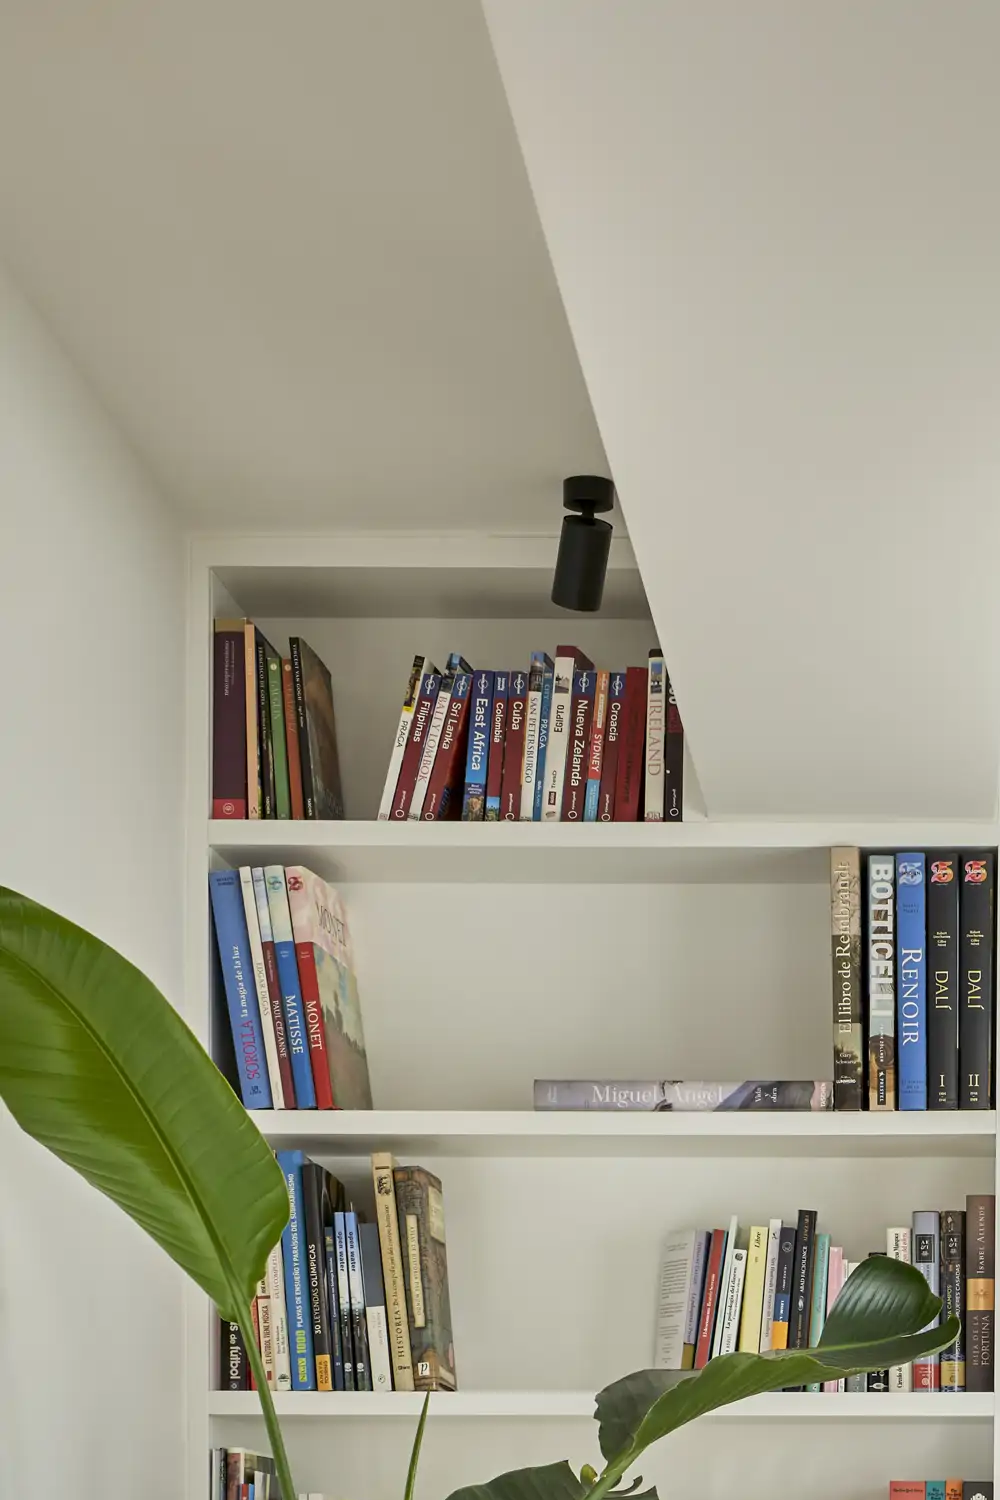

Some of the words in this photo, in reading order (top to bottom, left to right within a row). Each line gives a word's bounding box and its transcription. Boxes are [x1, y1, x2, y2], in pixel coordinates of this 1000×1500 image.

[413, 700, 430, 743] Filipinas
[452, 701, 462, 718] Sri
[475, 698, 489, 728] East
[493, 701, 504, 743] Colombia
[511, 700, 524, 731] Cuba
[529, 697, 538, 715] SAN
[553, 704, 564, 733] EGIPTO
[575, 699, 589, 737] Nueva
[609, 702, 621, 743] Croacia
[396, 720, 408, 748] PRAGA
[443, 718, 458, 750] Lanka
[471, 730, 486, 772] Africa
[525, 716, 536, 784] PETERSBURGO
[539, 718, 549, 750] PRAGA
[648, 699, 663, 777] IRELAND
[571, 739, 585, 787] Zelanda
[592, 733, 603, 773] SYDNEY
[834, 860, 853, 959] Rembrandt
[871, 863, 895, 1018] BOTTICELLI
[256, 961, 267, 990] EDGAR
[839, 961, 852, 978] de
[237, 983, 248, 1005] magia
[260, 991, 271, 1017] DEGAS
[838, 983, 852, 1016] libro
[901, 947, 923, 1046] RENOIR
[934, 970, 952, 1011] DALÍ
[967, 970, 985, 1011] DALÍ
[285, 995, 304, 1055] MATISSE
[306, 1000, 322, 1051] MONET
[837, 1018, 852, 1034] El
[241, 1019, 261, 1081] SOROLLA
[592, 1082, 661, 1108] Miguel
[753, 1231, 762, 1250] Libre
[976, 1204, 985, 1243] ALLENDE
[308, 1243, 318, 1288] OLÍMPICAS
[349, 1252, 357, 1272] water
[976, 1250, 985, 1274] ISABEL
[310, 1288, 319, 1325] LEYENDAS
[313, 1325, 320, 1335] 30
[392, 1308, 405, 1358] HISTORIA
[981, 1315, 991, 1367] FORTUNA
[229, 1346, 241, 1380] fútbol
